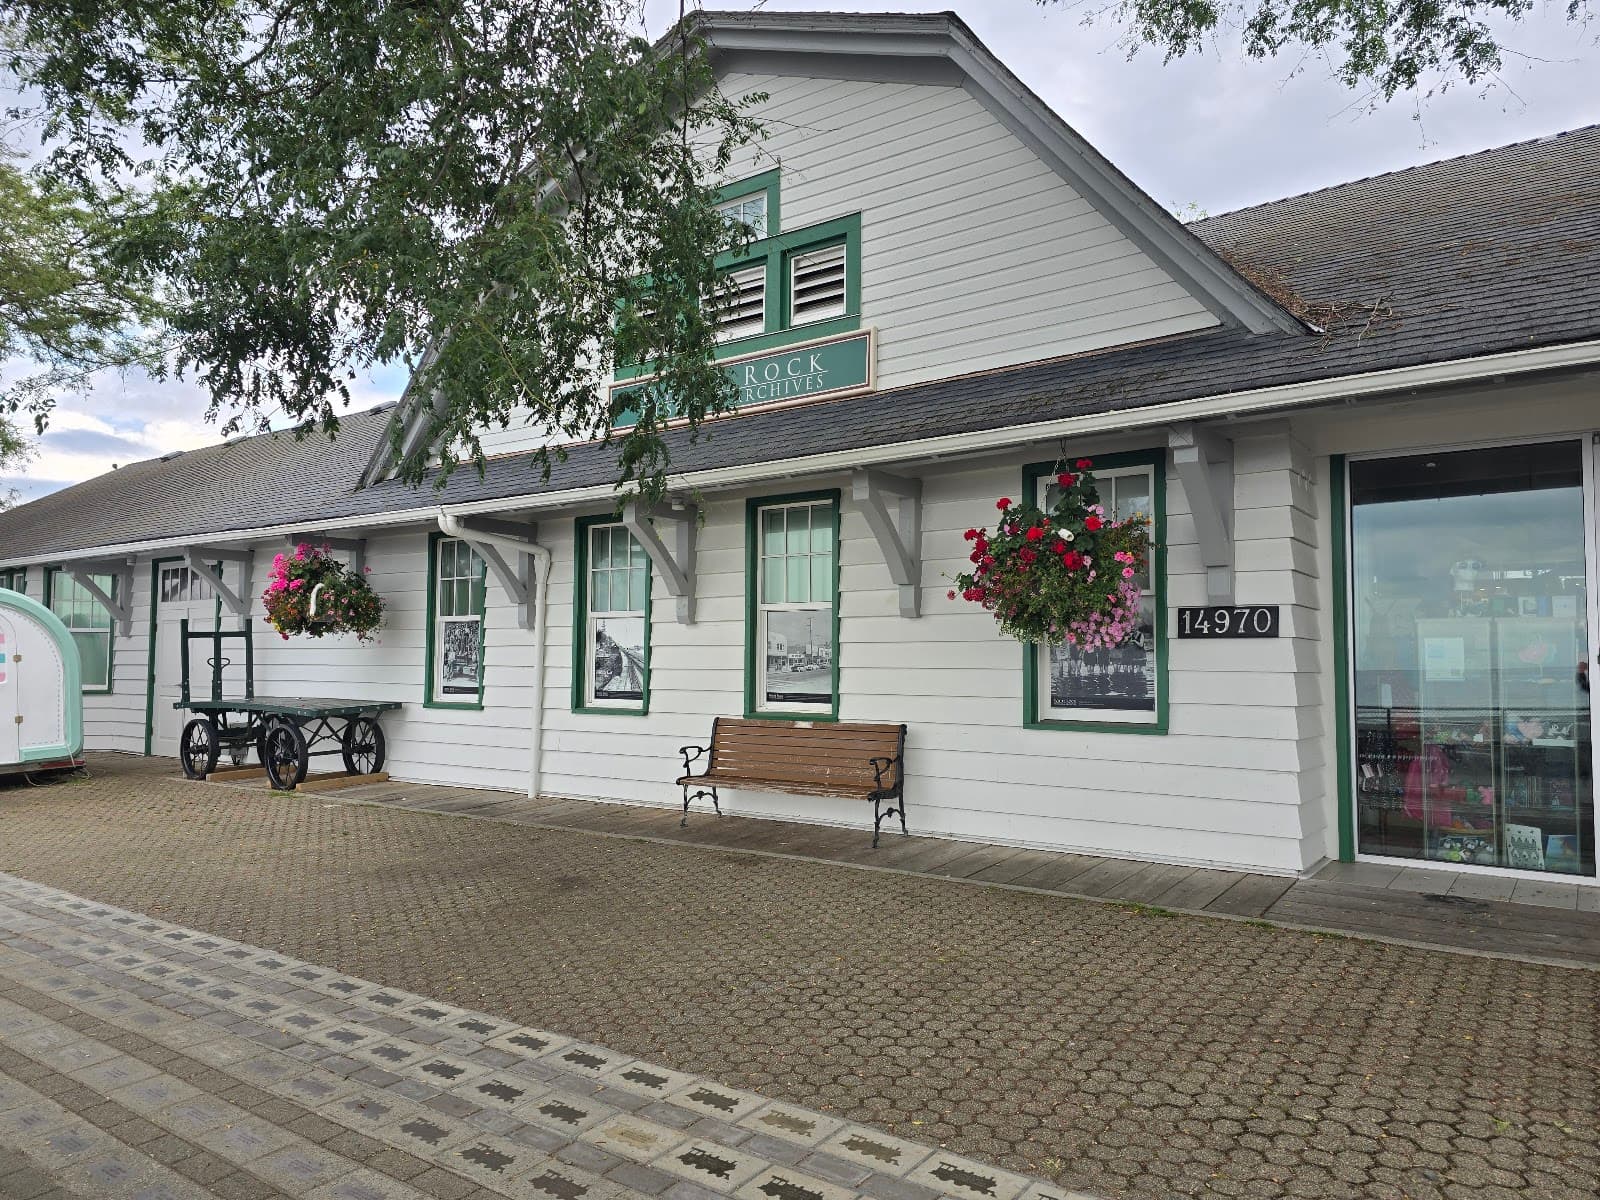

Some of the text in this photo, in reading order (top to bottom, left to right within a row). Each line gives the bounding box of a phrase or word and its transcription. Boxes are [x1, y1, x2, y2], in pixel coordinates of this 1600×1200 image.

[744, 353, 823, 386] ROCK
[738, 374, 823, 403] RCHIVES
[1182, 608, 1271, 634] 14970
